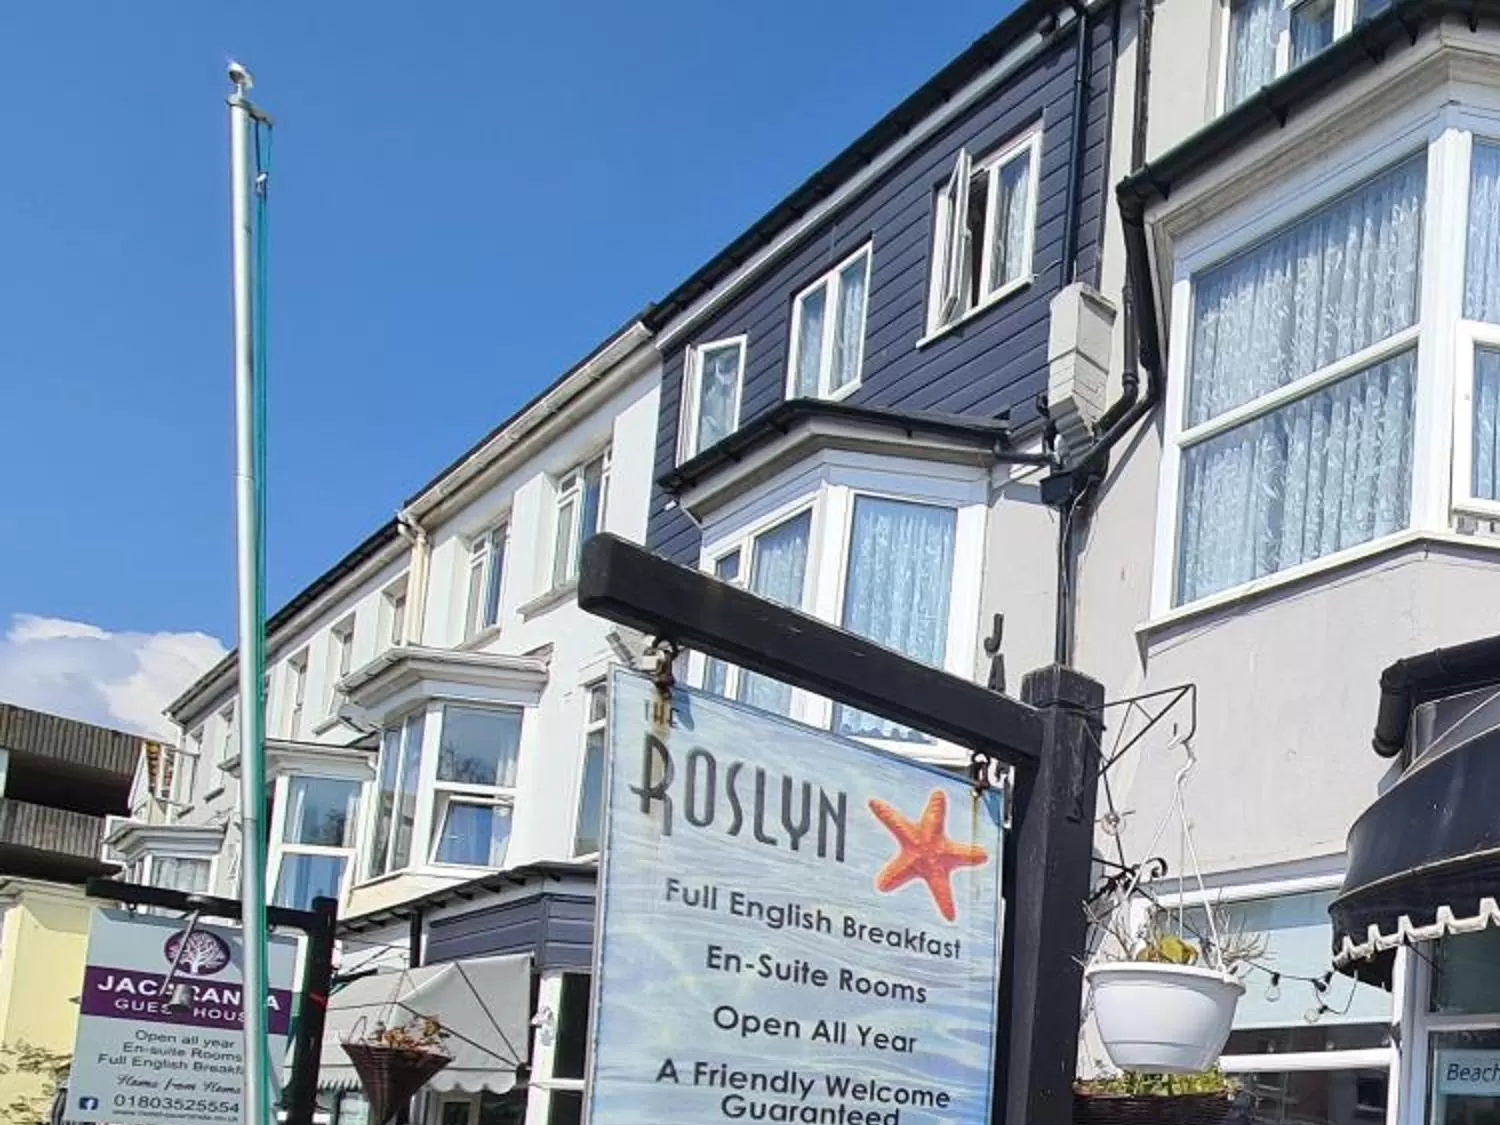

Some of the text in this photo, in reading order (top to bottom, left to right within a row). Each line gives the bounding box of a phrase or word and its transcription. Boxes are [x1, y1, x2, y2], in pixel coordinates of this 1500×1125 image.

[629, 733, 847, 862] ROSLYN
[665, 877, 961, 960] Full English Breakfast
[97, 975, 281, 1011] JACANA
[706, 944, 928, 1004] En-Suite Rooms
[114, 999, 247, 1023] GUES HOUS
[713, 1005, 917, 1053] Open All Year
[135, 1029, 235, 1049] Open all year
[191, 1047, 242, 1062] Rooms
[97, 1053, 127, 1065] Full
[131, 1056, 188, 1071] English
[656, 1058, 951, 1109] A Friendly Welcome
